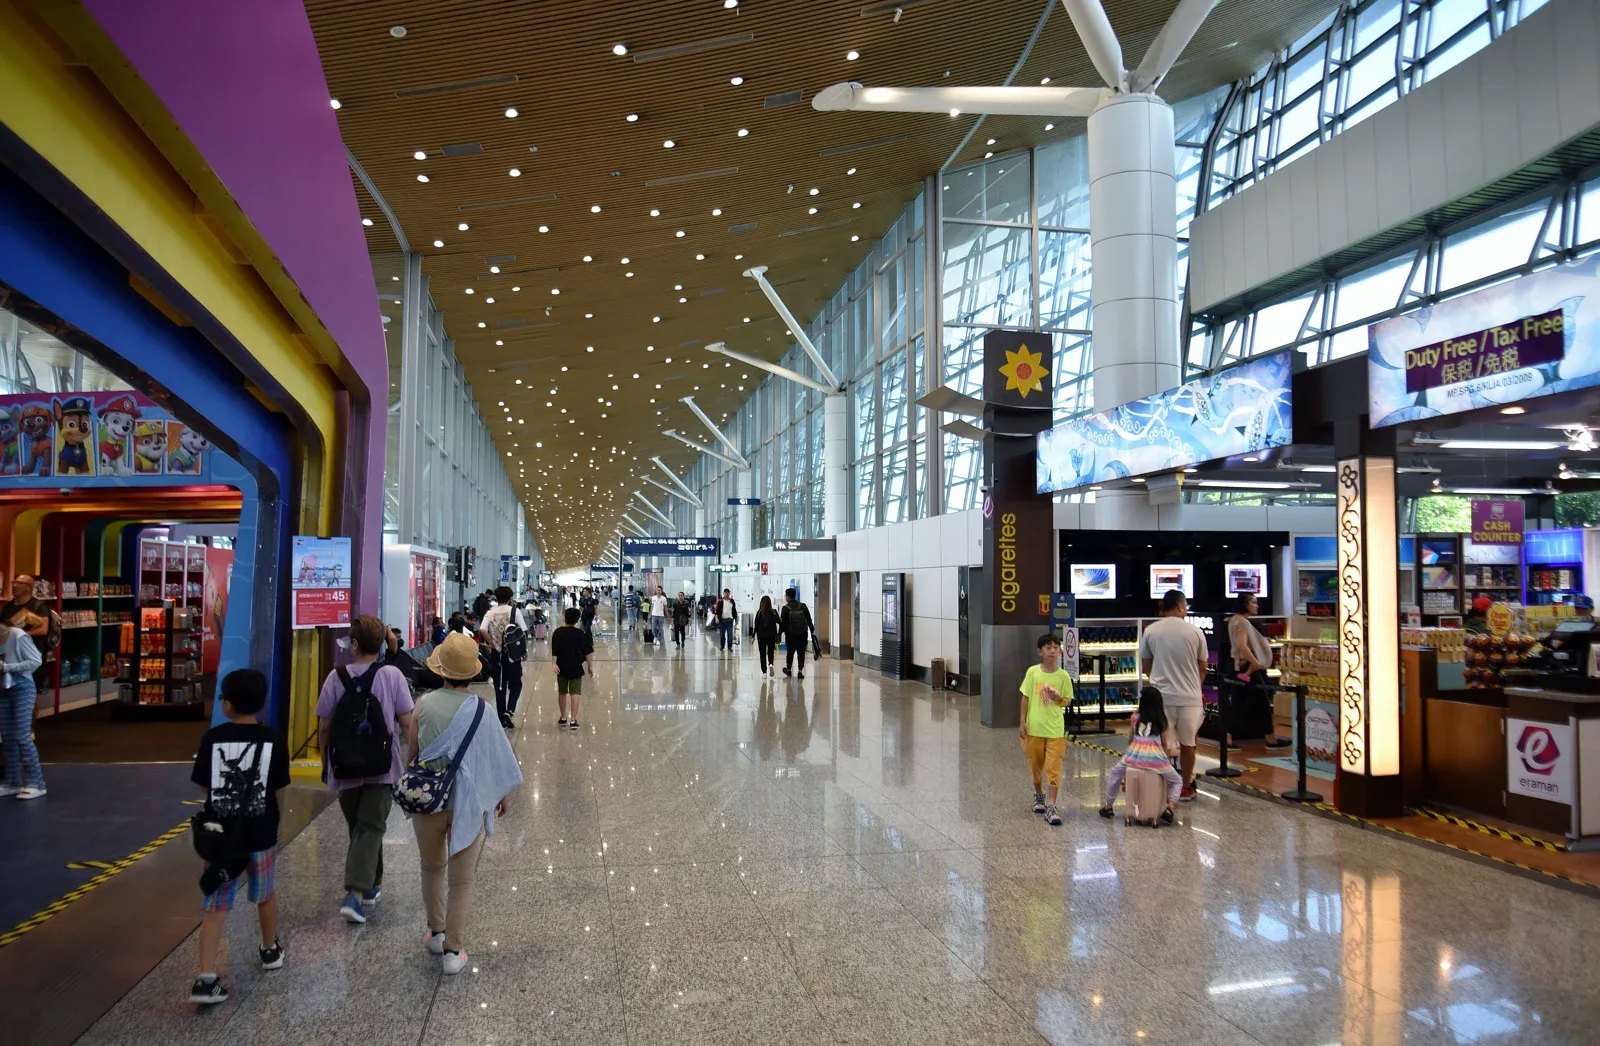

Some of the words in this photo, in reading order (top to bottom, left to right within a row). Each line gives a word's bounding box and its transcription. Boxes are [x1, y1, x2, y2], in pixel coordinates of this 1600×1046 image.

[1406, 347, 1440, 369] Duty
[1443, 337, 1478, 360] Free
[1490, 326, 1521, 348] Tax
[1523, 315, 1564, 340] Free
[1482, 520, 1511, 531] CASH
[1473, 532, 1522, 543] COUNTER
[999, 513, 1020, 612] cigarettes
[332, 591, 345, 601] 45
[1519, 777, 1559, 794] eraman
